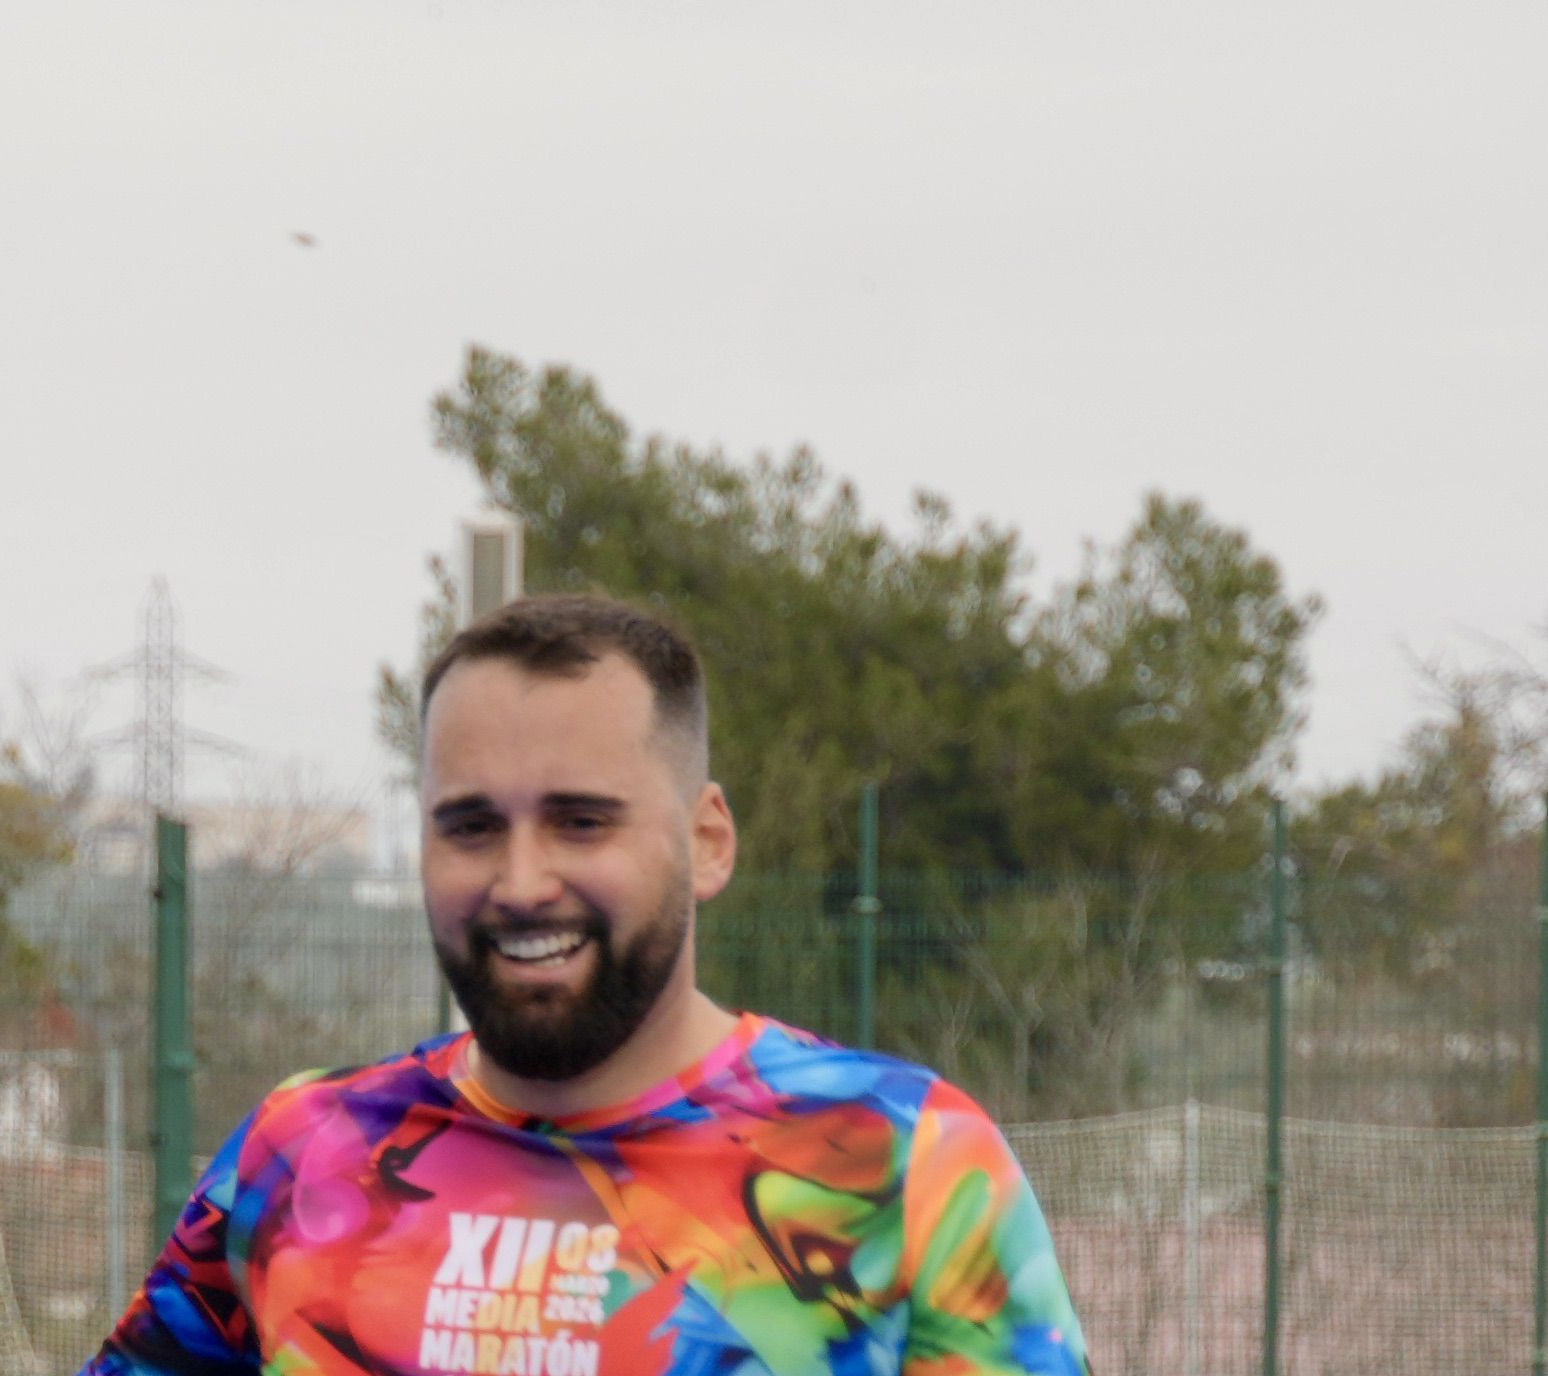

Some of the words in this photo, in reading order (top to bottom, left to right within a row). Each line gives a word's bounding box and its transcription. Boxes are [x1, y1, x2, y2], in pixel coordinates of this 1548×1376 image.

[433, 1212, 556, 1293] XII
[556, 1221, 621, 1273] 08
[424, 1286, 541, 1334] MEDIA
